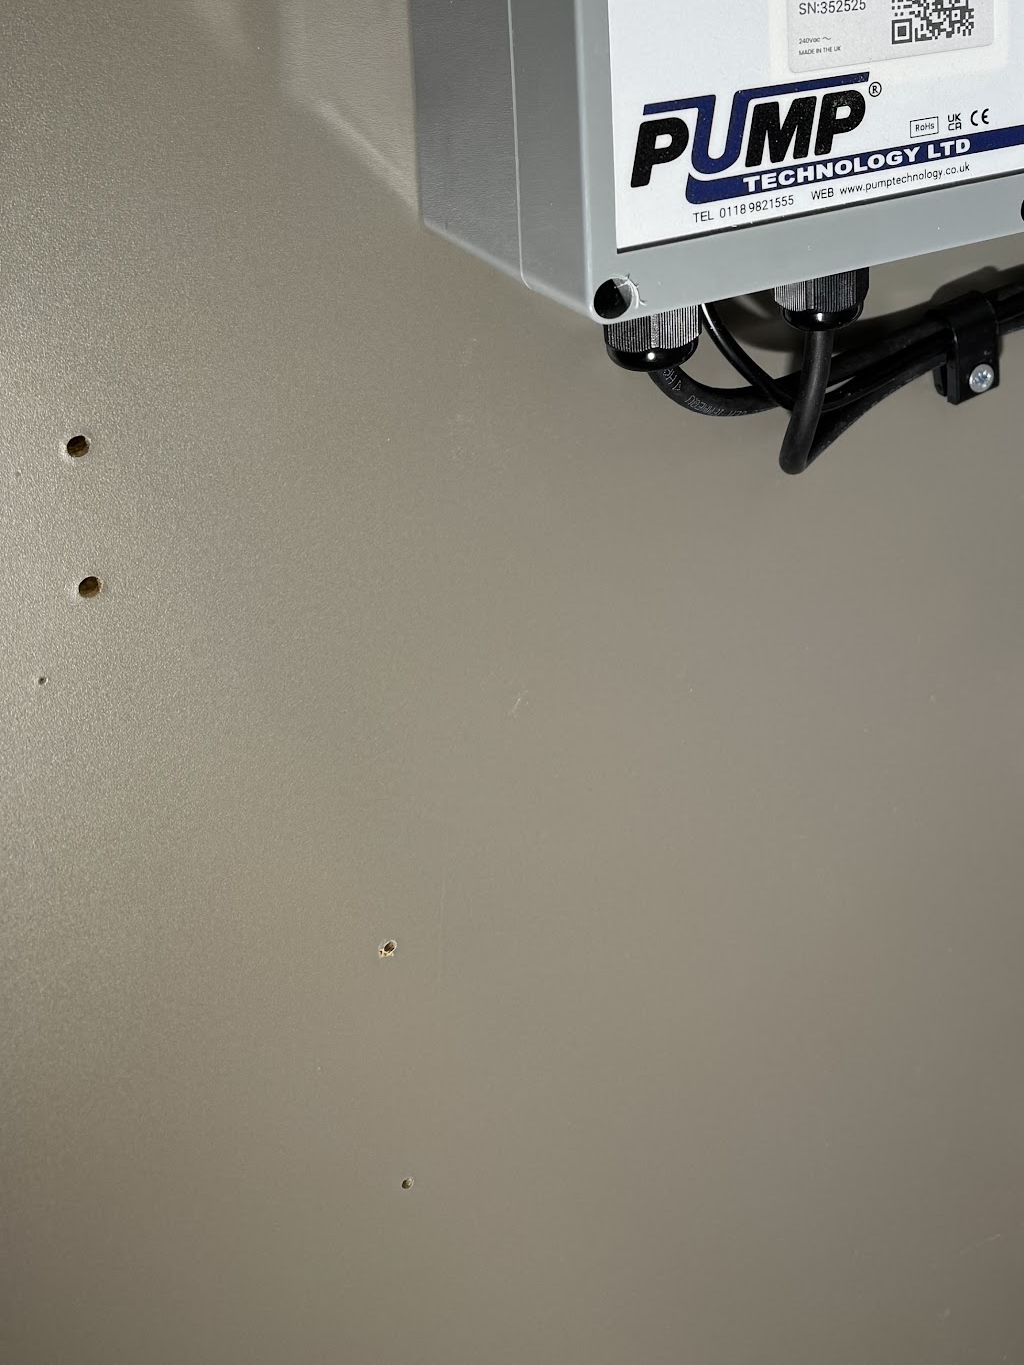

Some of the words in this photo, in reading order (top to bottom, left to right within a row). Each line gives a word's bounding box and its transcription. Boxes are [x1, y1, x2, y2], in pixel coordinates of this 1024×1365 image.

[630, 71, 869, 189] PUMP
[693, 211, 714, 223] TEL
[719, 203, 747, 219] 0118
[748, 195, 794, 213] 9821555
[811, 187, 834, 201] WEB
[839, 163, 970, 197] www.pumptechnology.co.uk
[743, 145, 921, 192] TECHNOLOGY
[926, 138, 971, 158] LTD
